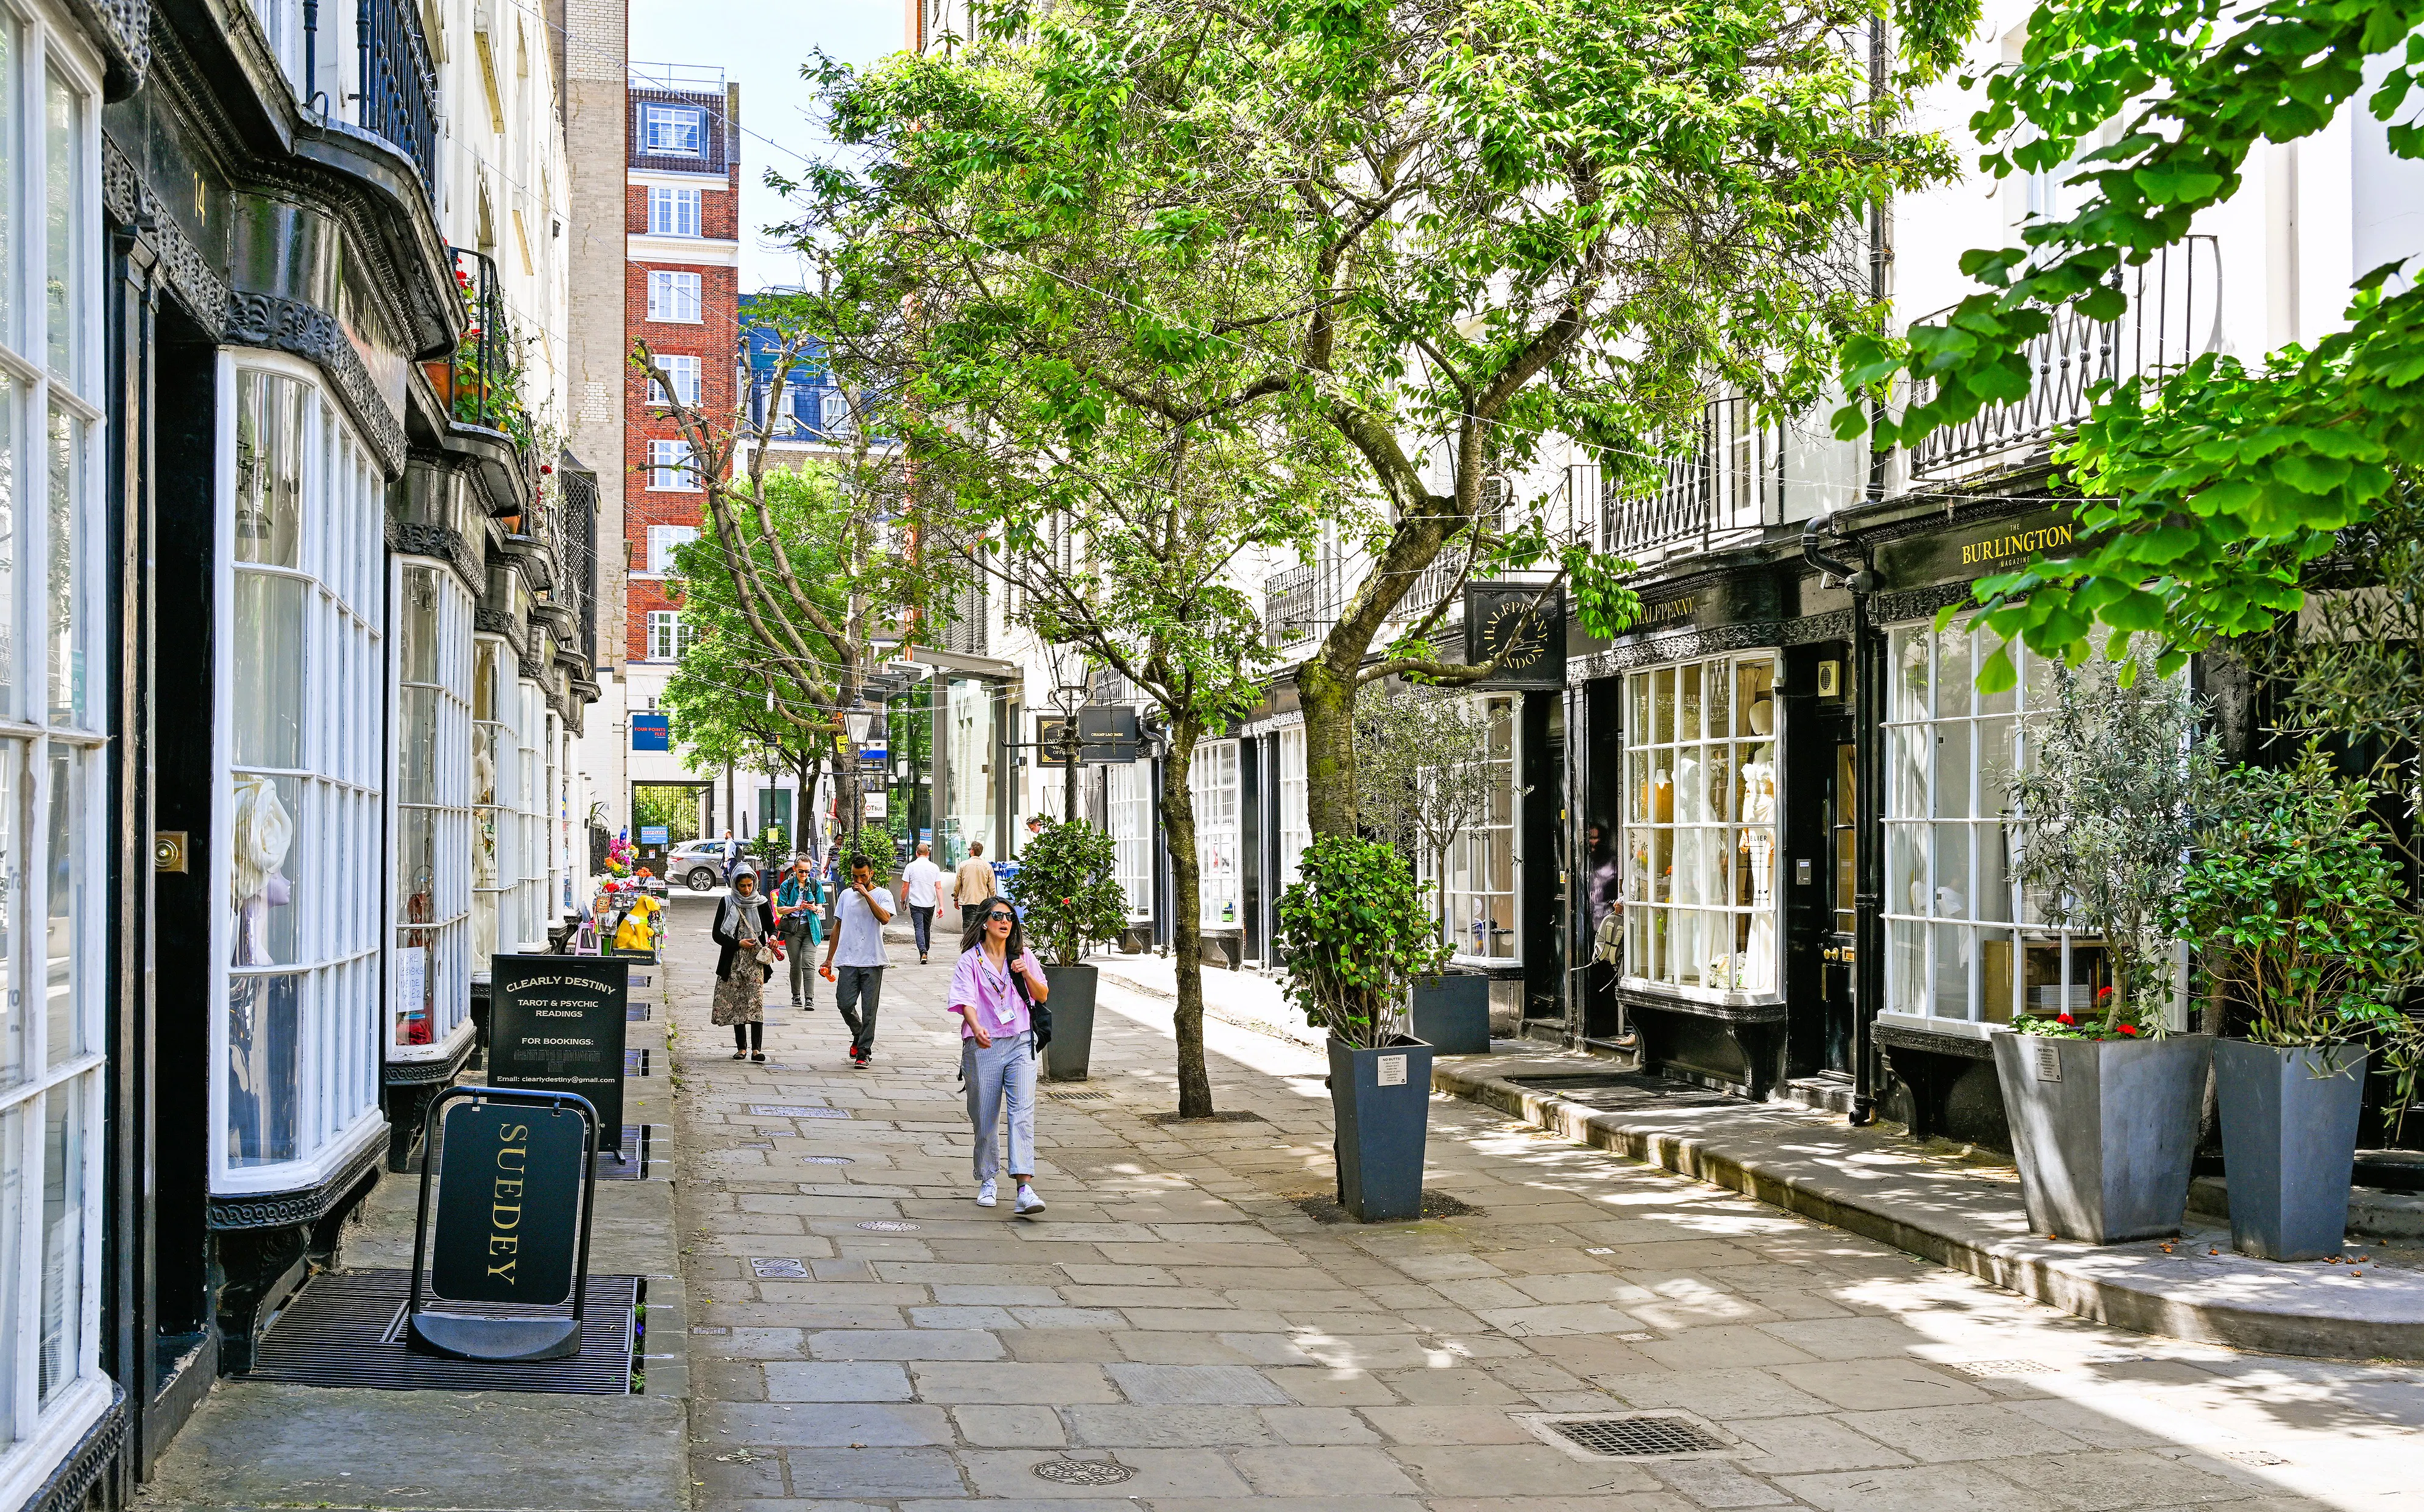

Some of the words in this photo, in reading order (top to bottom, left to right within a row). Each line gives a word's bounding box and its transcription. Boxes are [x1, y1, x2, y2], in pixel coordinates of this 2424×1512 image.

[194, 171, 205, 227] 14
[1962, 523, 2072, 565] BURLINGTON
[2001, 556, 2030, 567] MAGAZINE
[1657, 624, 1674, 633] LONDON
[1487, 643, 1545, 669] LNDON
[400, 954, 418, 965] MORE
[400, 967, 424, 976] BOOKS
[399, 979, 420, 988] INSIDE
[506, 977, 561, 992] CLEARLY
[565, 977, 616, 995] DESTINY
[487, 1123, 528, 1285] SUEDEY
